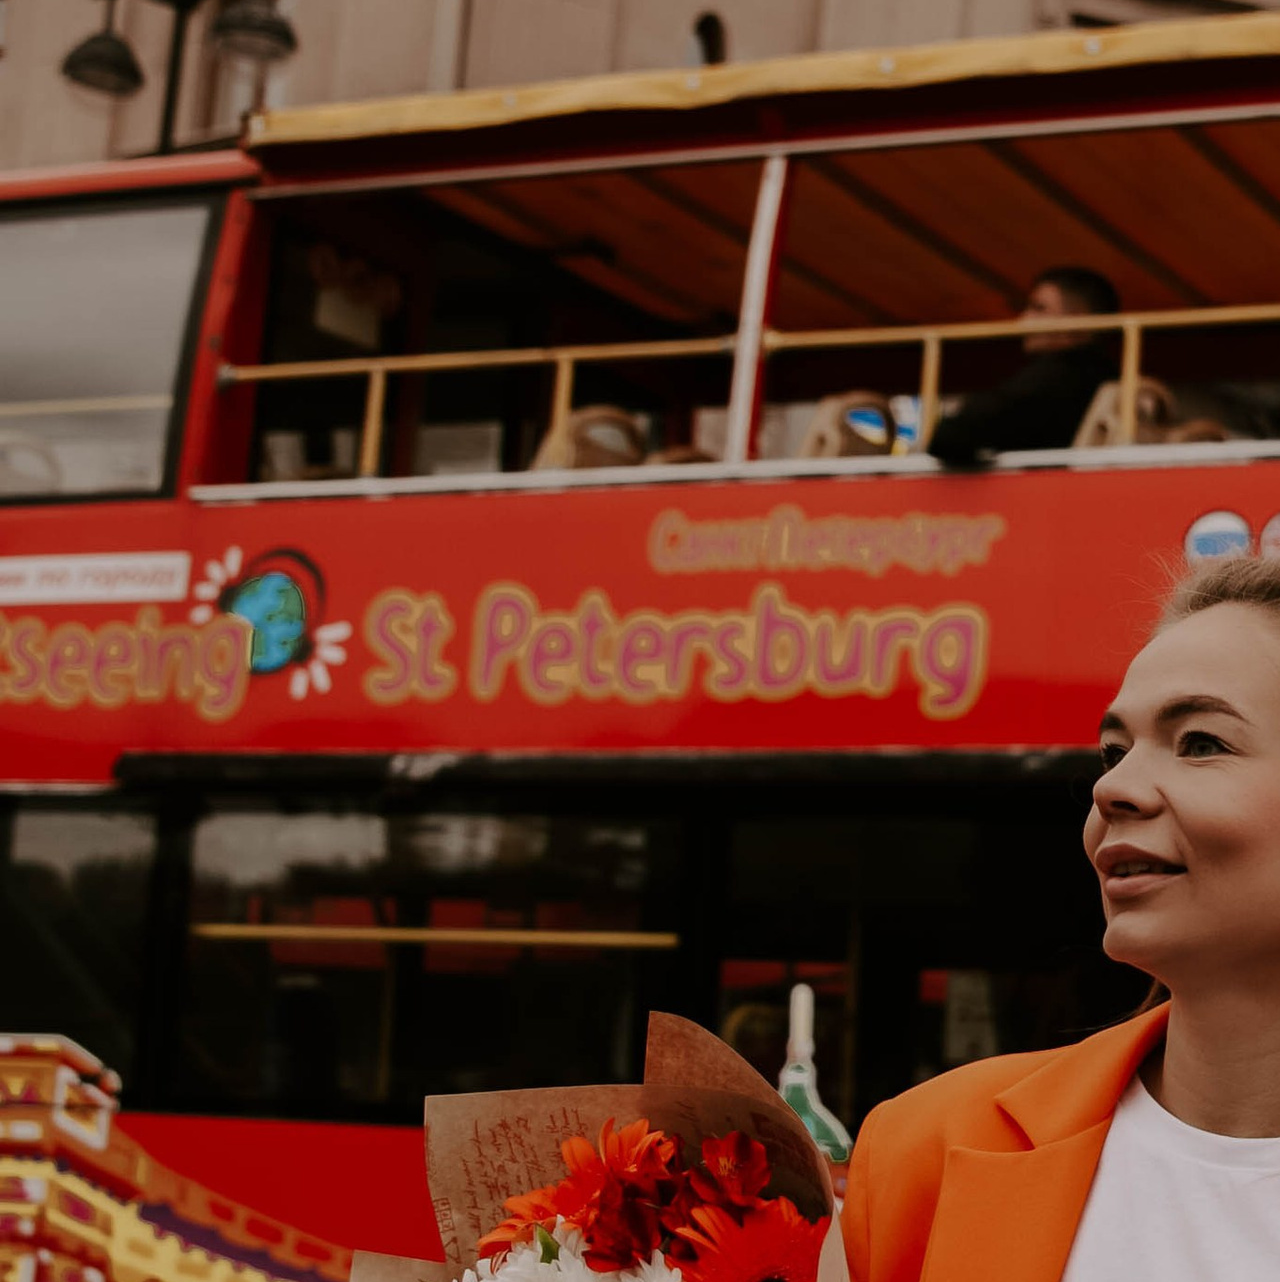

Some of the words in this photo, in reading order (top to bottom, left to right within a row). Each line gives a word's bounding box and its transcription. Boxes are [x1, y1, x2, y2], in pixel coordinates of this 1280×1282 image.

[0, 604, 253, 724] seeing
[364, 587, 456, 707] St
[469, 580, 989, 720] Petersburg
